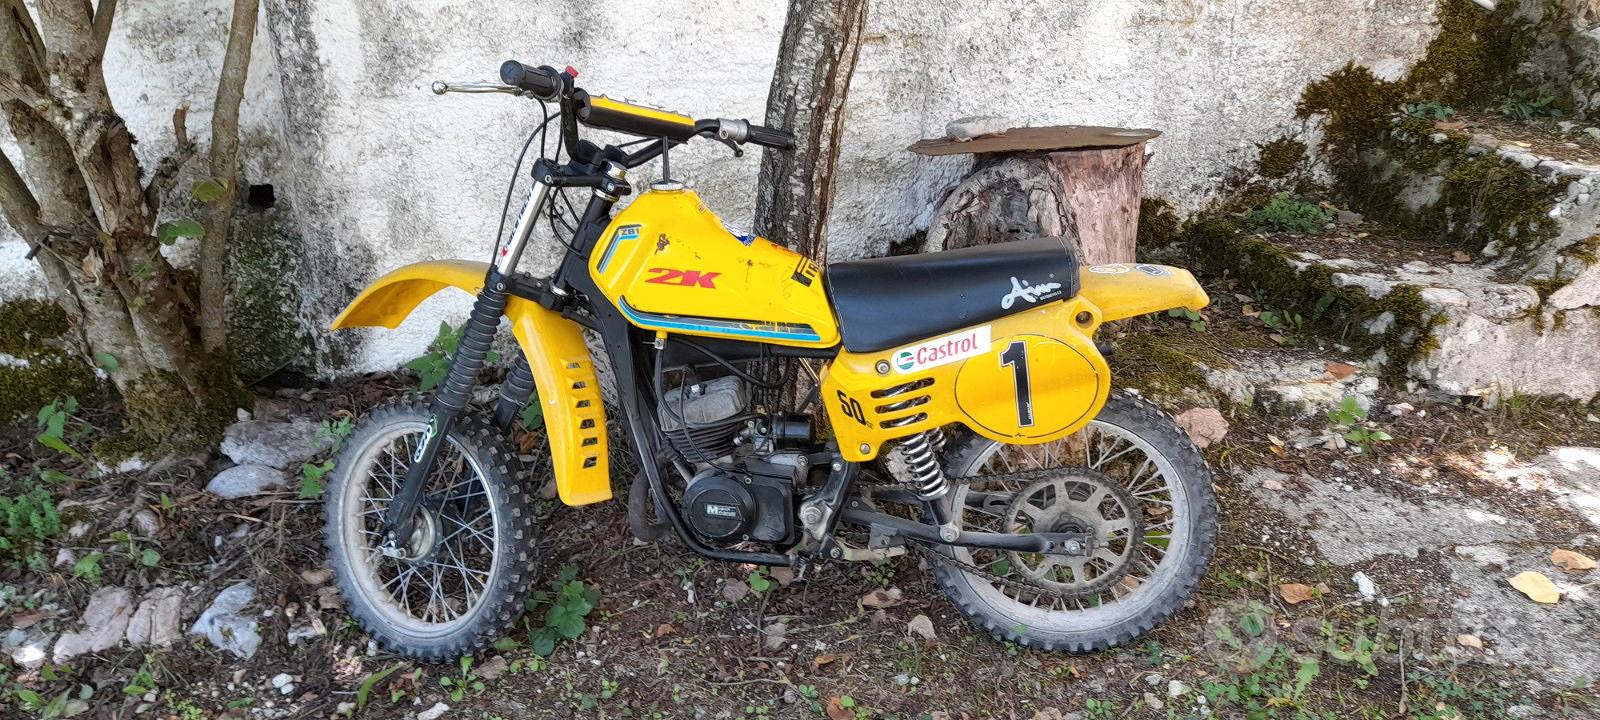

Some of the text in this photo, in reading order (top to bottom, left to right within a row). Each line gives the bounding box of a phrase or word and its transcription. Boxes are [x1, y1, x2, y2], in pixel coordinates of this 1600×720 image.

[644, 267, 721, 289] 2K
[917, 333, 978, 364] Castrol
[1000, 341, 1036, 428] 1
[836, 389, 867, 426] 50
